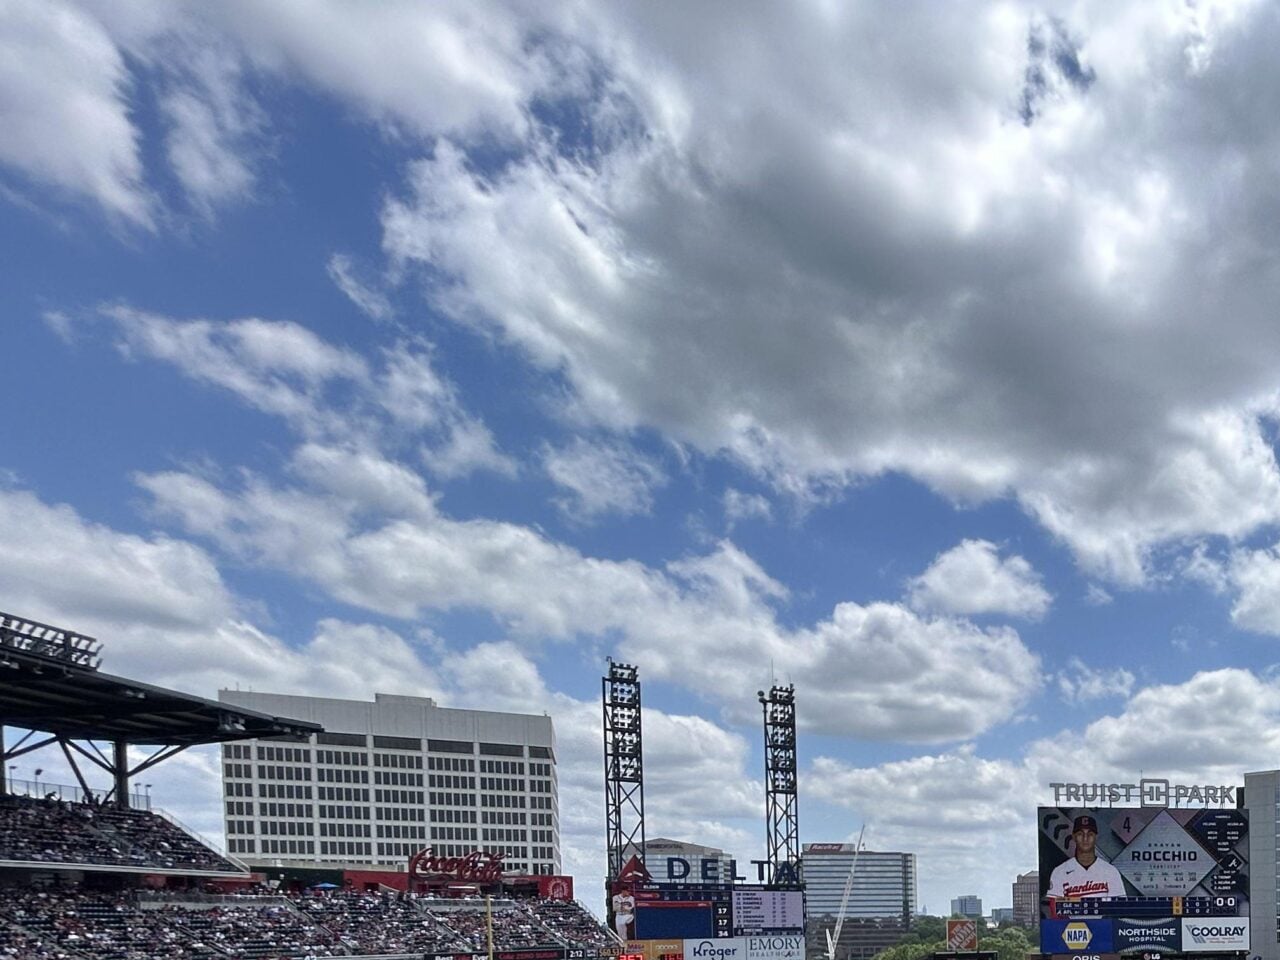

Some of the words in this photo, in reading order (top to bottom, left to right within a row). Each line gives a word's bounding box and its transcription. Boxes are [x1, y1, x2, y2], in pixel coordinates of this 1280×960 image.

[1049, 782, 1136, 804] TRUIST
[1174, 784, 1236, 805] PARK
[1122, 816, 1132, 833] 4
[1131, 850, 1198, 862] ROCCHIO
[666, 856, 801, 885] DELTA
[1062, 879, 1110, 897] Guardians
[1216, 897, 1223, 907] 0
[1227, 897, 1235, 907] 0
[1067, 929, 1088, 942] NAPA
[1118, 928, 1176, 936] NORTHSIDE
[1191, 926, 1246, 937] COOLRAY
[750, 938, 802, 950] EMORY
[569, 950, 583, 958] 2:12
[750, 950, 801, 958] HEALTHCARE
